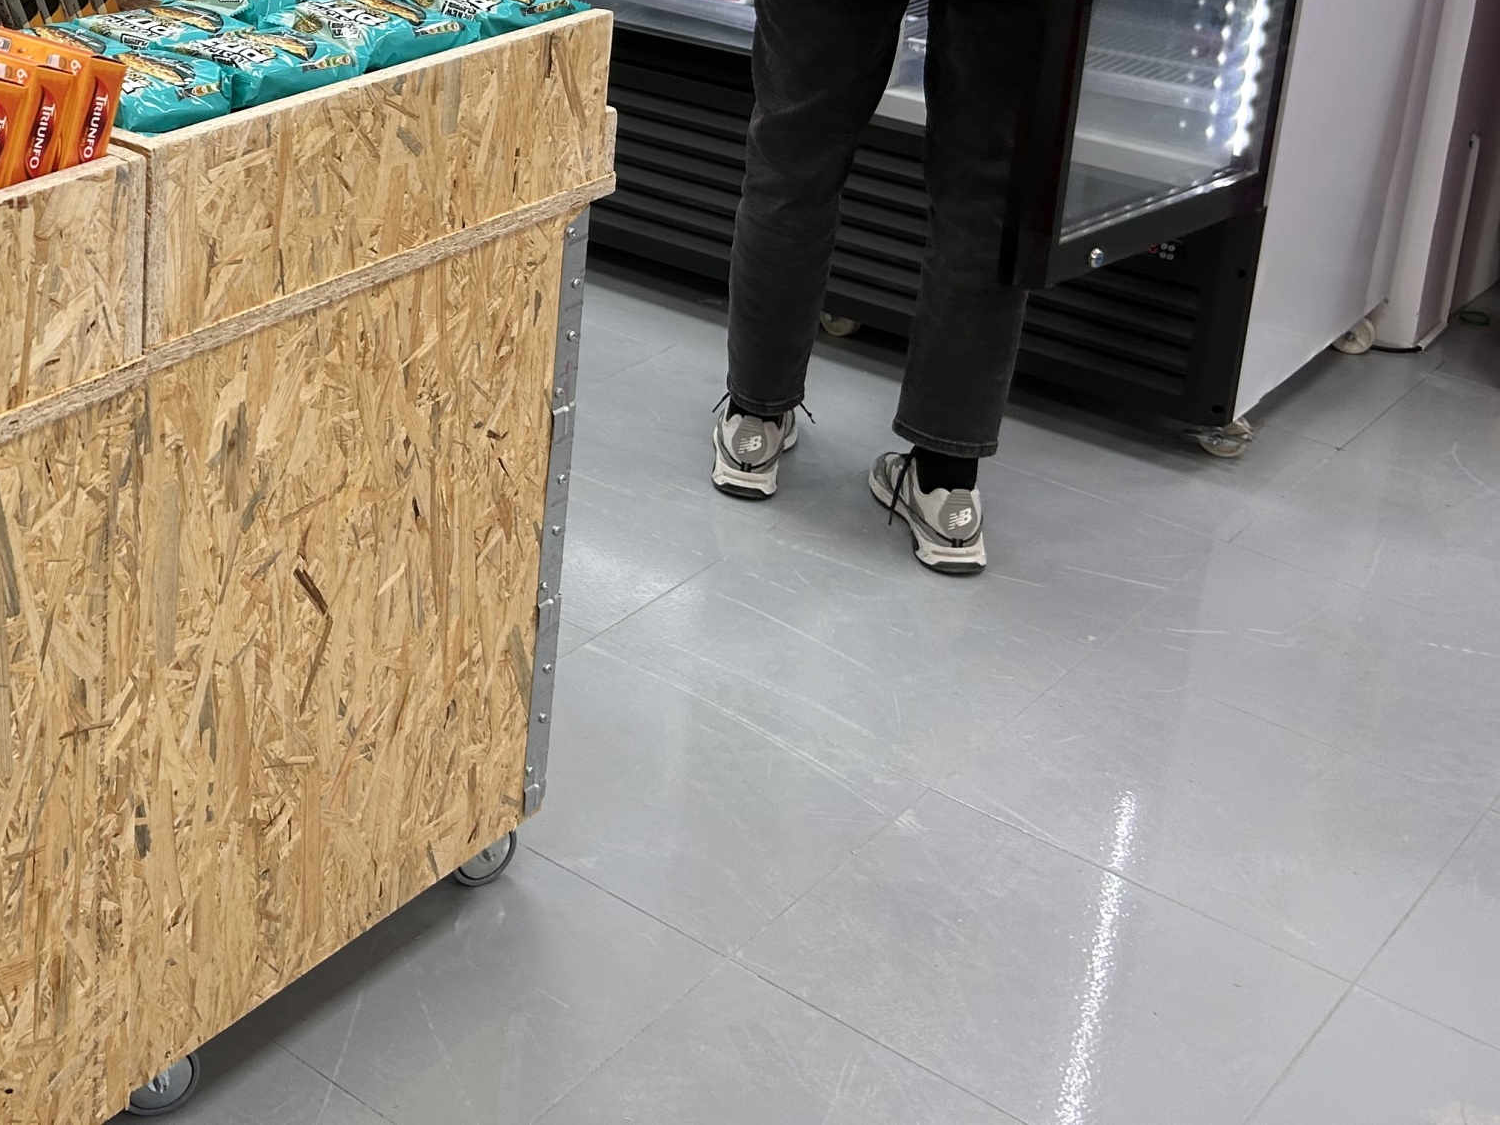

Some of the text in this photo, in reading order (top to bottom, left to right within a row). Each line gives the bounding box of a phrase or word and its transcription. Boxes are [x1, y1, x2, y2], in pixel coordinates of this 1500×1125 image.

[16, 67, 28, 85] 6x
[69, 58, 83, 76] 6x
[27, 102, 57, 171] TRIUNFO
[81, 92, 109, 160] TRIUNFO
